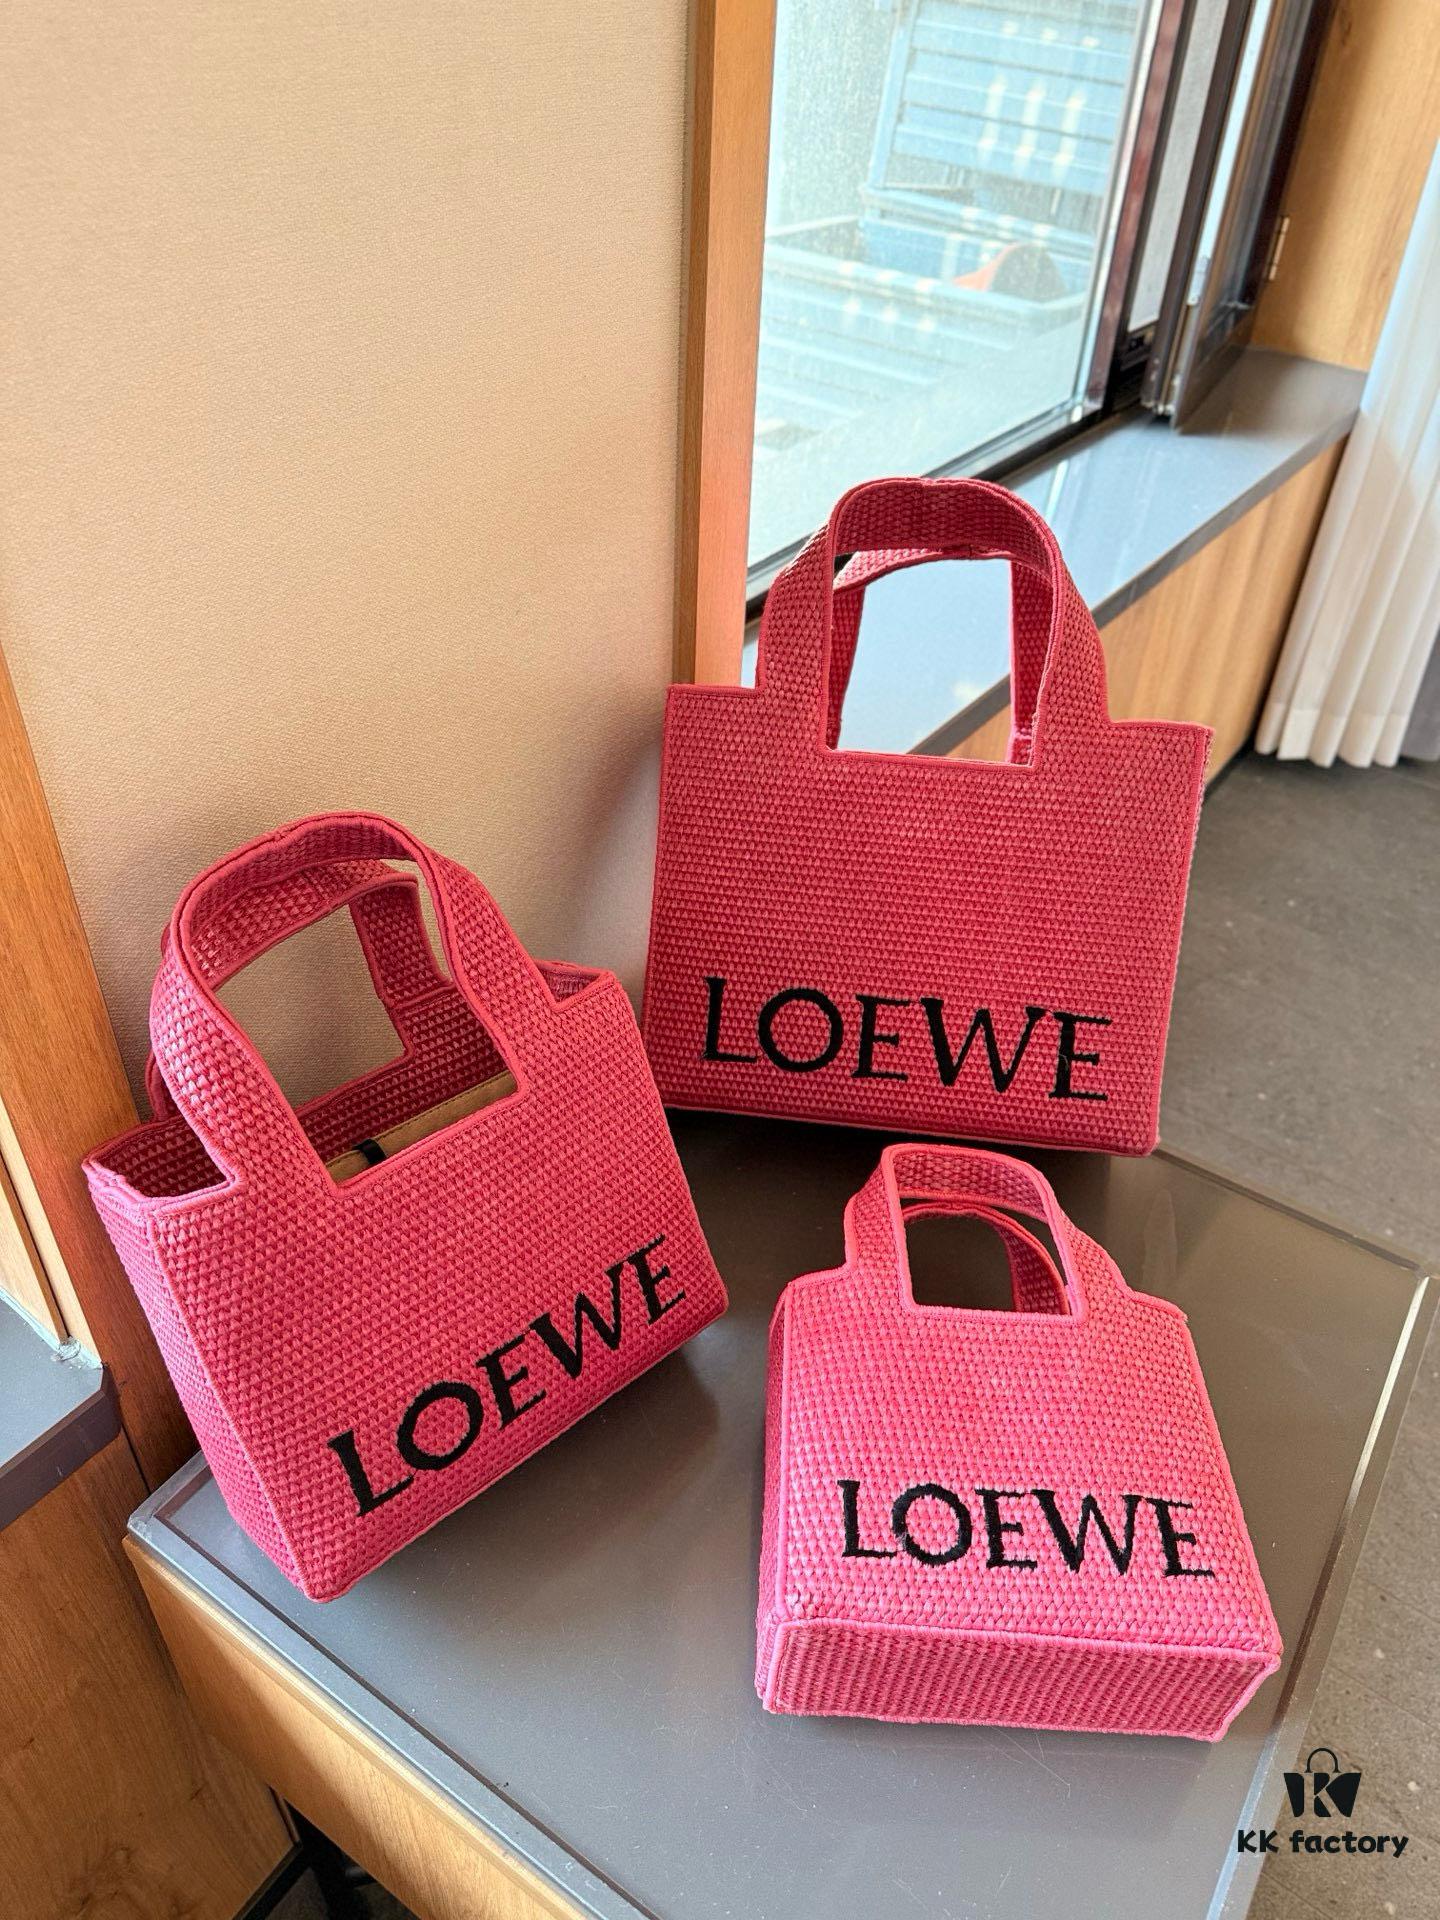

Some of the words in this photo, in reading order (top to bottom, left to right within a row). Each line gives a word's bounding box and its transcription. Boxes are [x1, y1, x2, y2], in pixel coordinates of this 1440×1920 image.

[702, 977, 1112, 1101] LOEWE
[328, 1234, 685, 1516] LOEWE
[839, 1480, 1214, 1577] LOEWE
